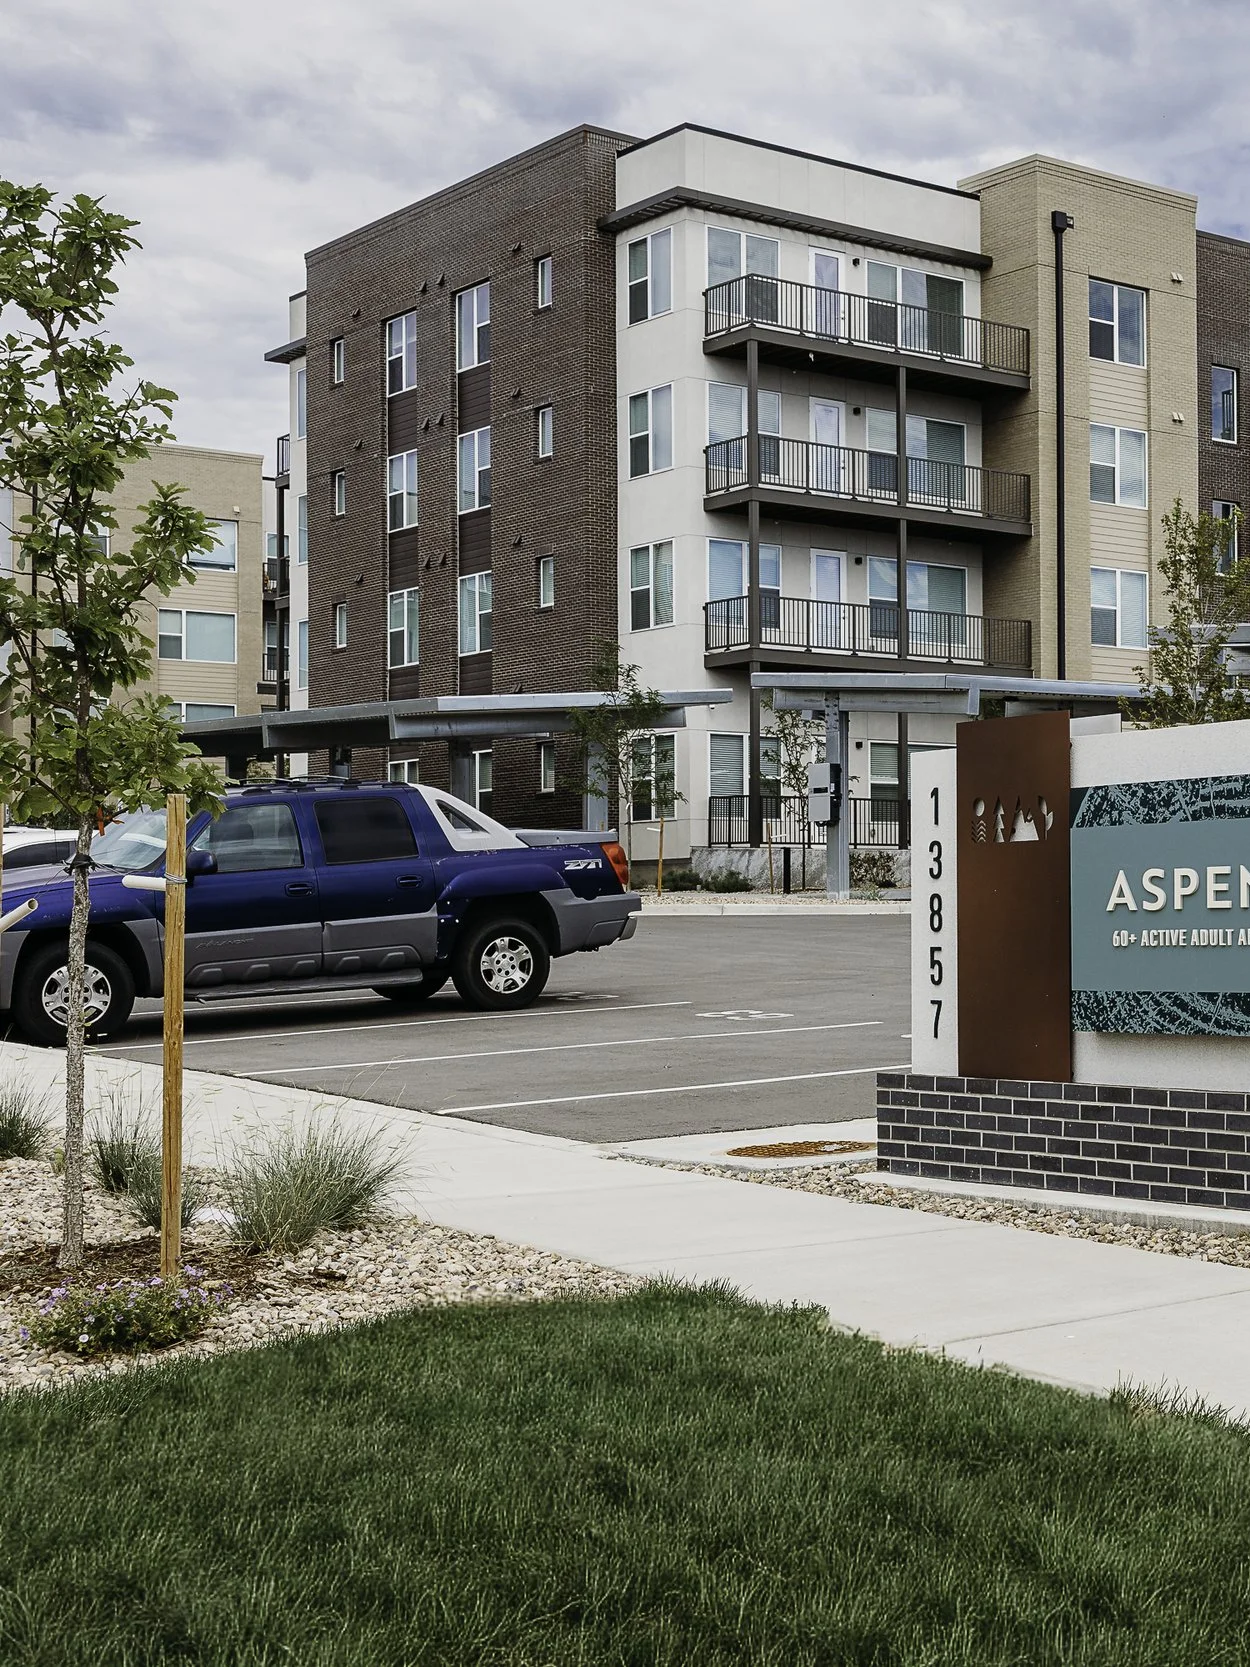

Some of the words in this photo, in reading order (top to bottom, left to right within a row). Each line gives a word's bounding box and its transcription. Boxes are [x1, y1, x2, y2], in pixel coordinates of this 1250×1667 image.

[928, 787, 943, 1039] 13857
[1112, 930, 1137, 947] 60+
[1140, 929, 1187, 947] ACTIVE
[1190, 928, 1234, 946] ADULT
